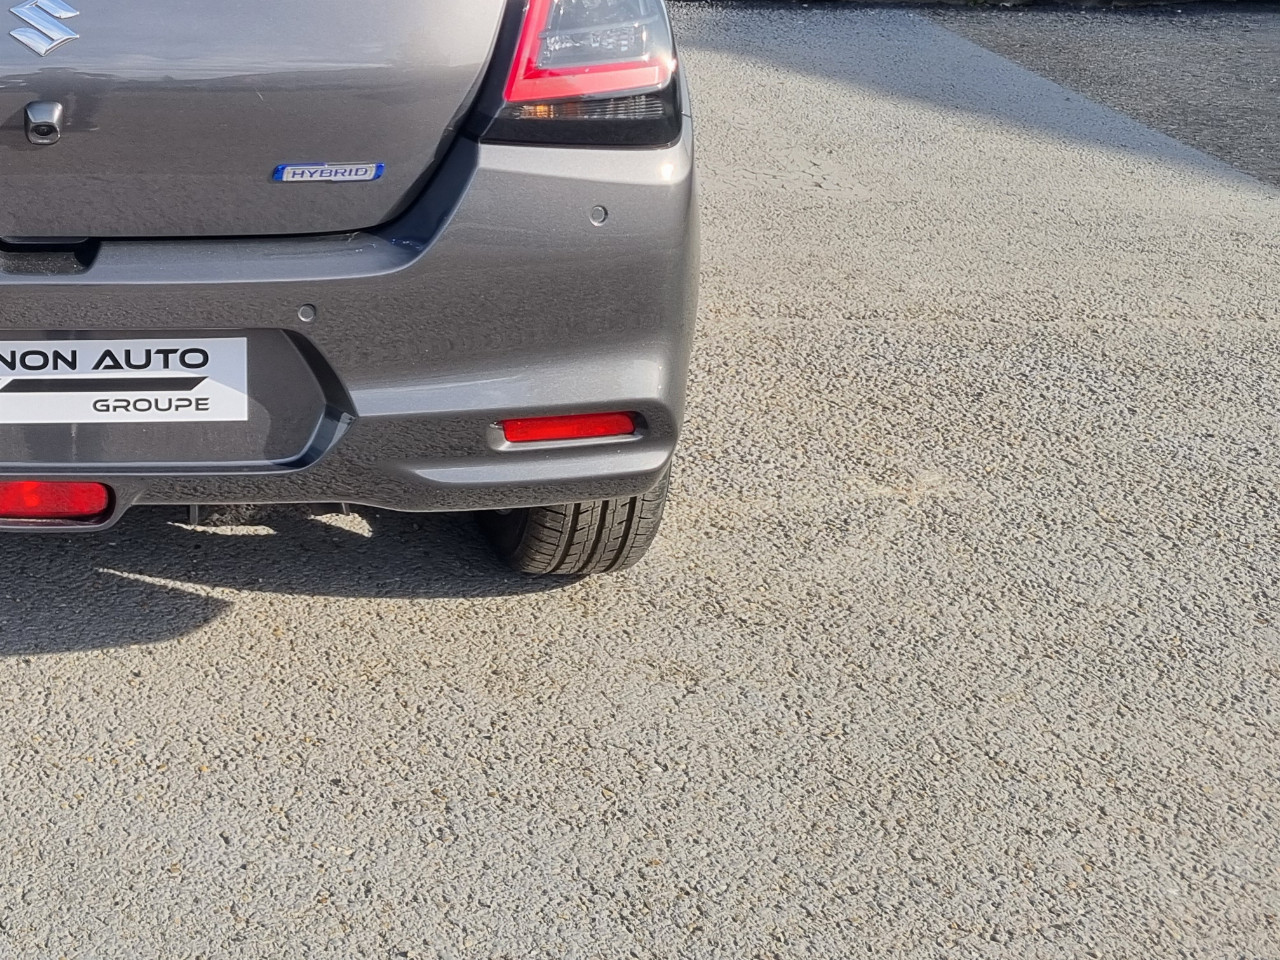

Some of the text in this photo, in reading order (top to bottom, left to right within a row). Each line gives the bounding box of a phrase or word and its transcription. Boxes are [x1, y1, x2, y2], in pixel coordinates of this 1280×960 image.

[291, 168, 368, 179] HYBRID
[92, 346, 209, 370] AUTO
[92, 397, 210, 413] GROUPE
